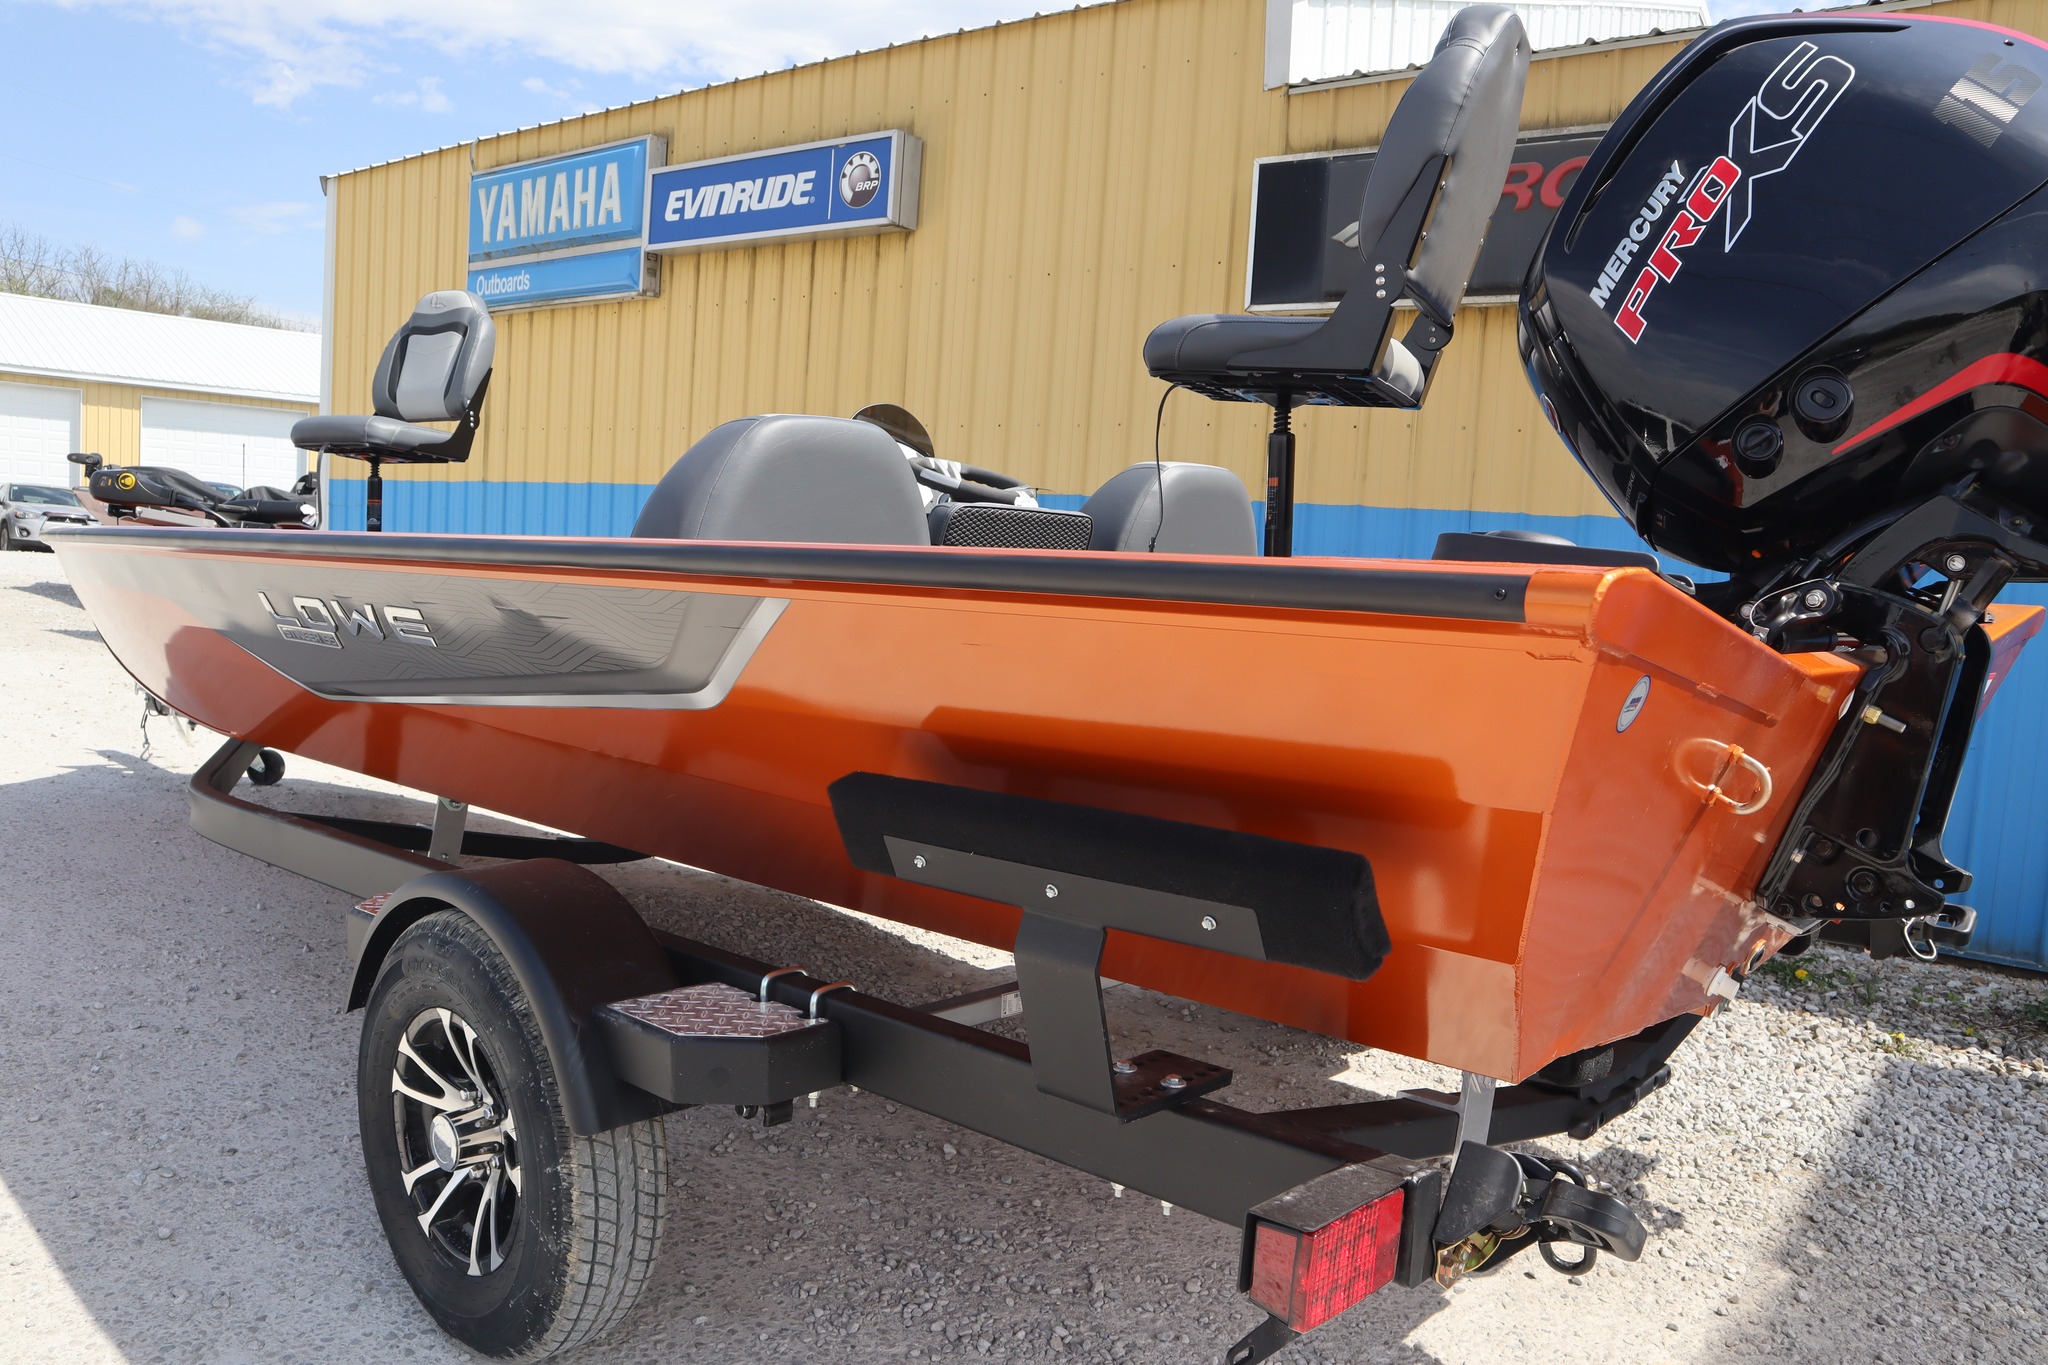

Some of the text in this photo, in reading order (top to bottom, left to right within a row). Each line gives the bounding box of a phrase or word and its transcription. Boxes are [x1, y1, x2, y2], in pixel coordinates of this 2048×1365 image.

[478, 162, 622, 244] YAMAHA
[664, 170, 816, 222] EVINRUDE
[855, 180, 879, 192] BRP
[1588, 159, 1686, 309] MERCURY
[1613, 156, 1742, 345] PRO
[476, 270, 530, 296] Outboards
[258, 591, 438, 647] LOWE
